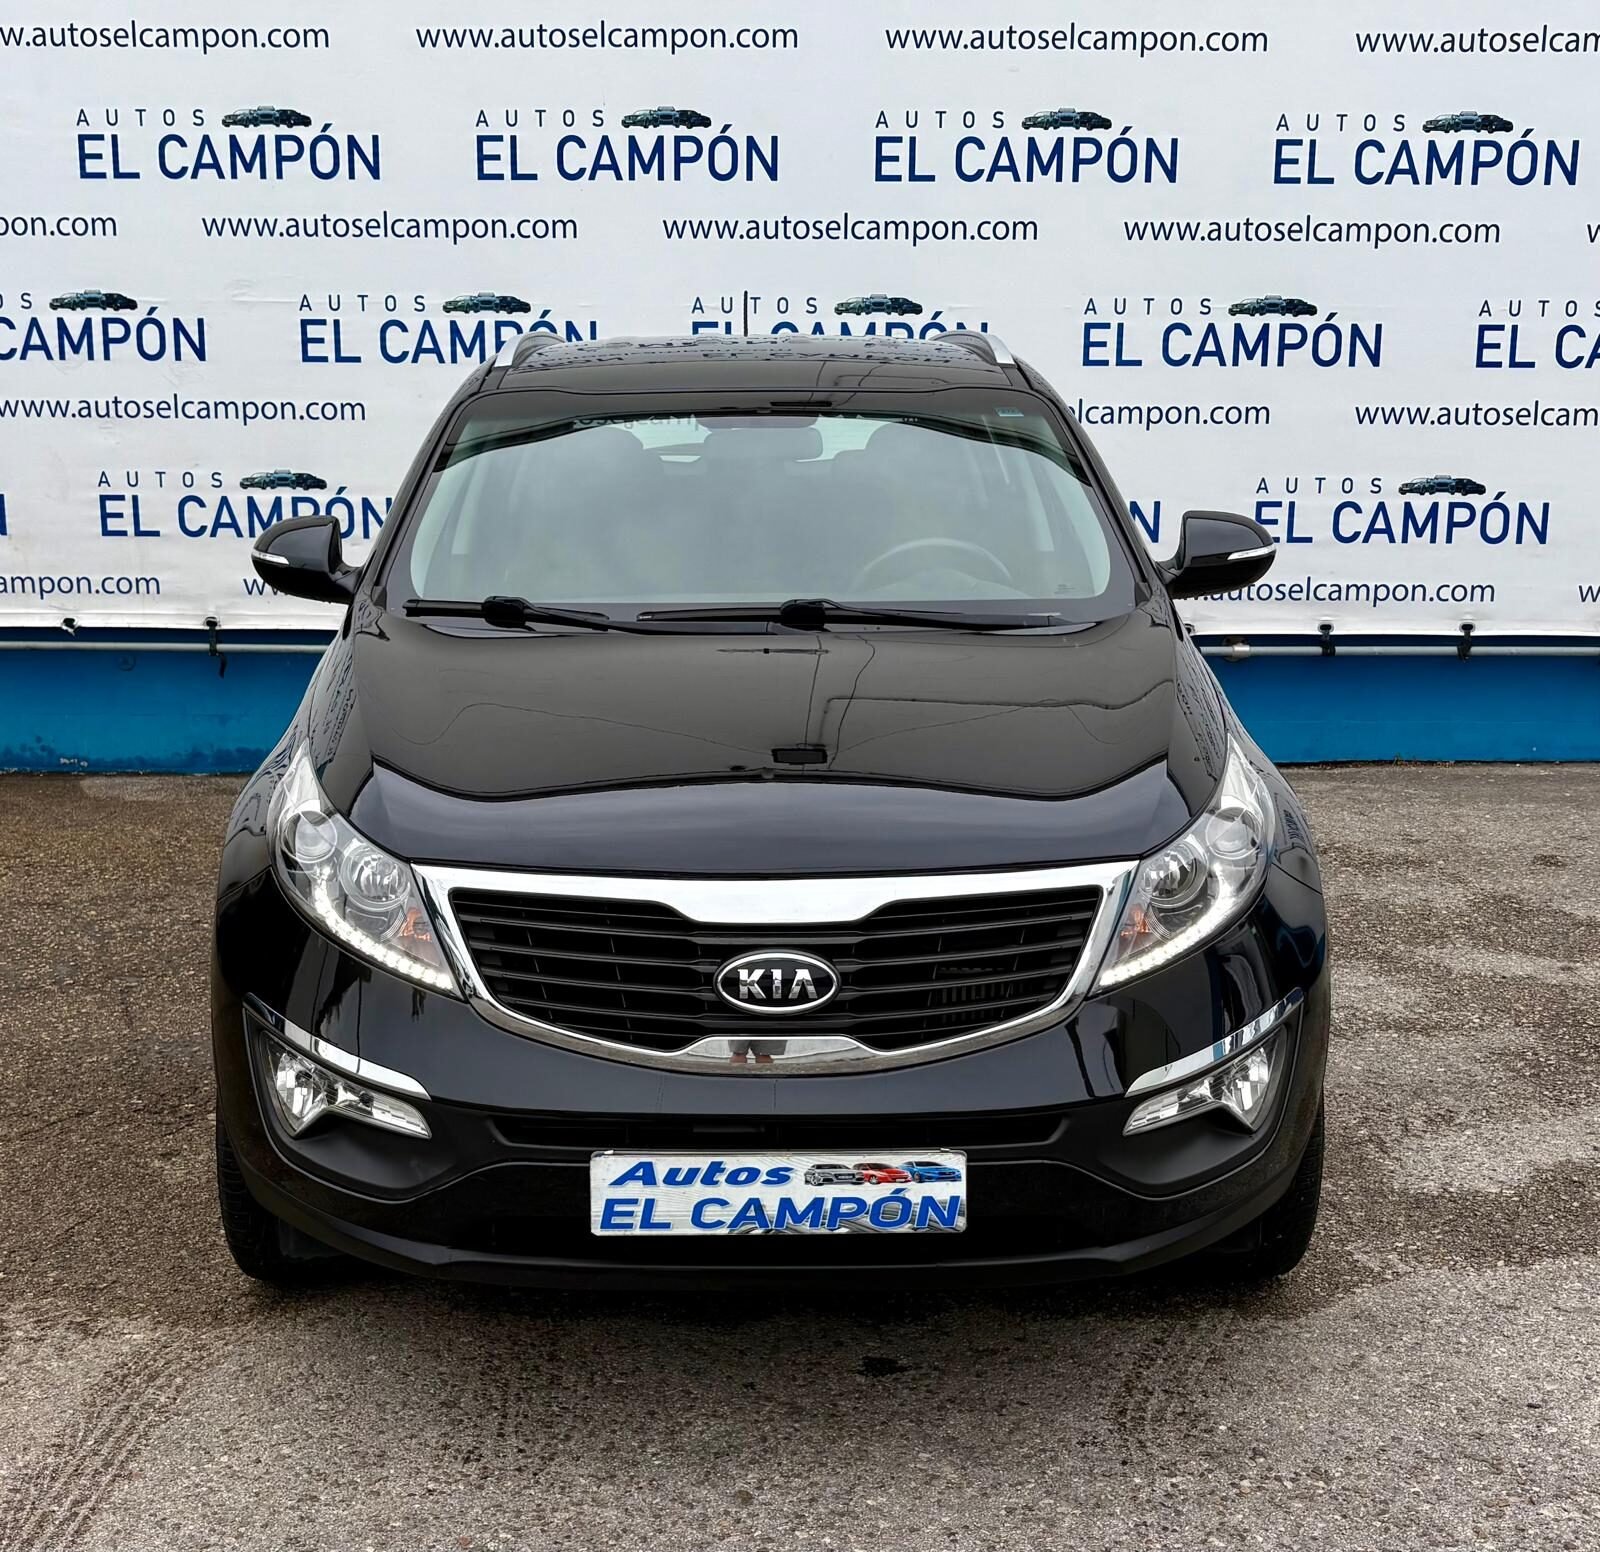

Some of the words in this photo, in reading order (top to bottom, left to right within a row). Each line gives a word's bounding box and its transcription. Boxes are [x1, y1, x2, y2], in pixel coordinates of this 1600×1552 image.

[416, 21, 798, 55] www.autoselcampon.com
[886, 23, 1269, 58] www.autoselcampon.com
[78, 110, 205, 127] AUTOS
[477, 110, 604, 128] AUTOS
[876, 111, 1005, 129] AUTOS
[1277, 114, 1405, 132] AUTOS
[79, 135, 140, 180] EL
[158, 123, 381, 181] CAMPÓN
[477, 136, 538, 181] EL
[557, 124, 779, 182] CAMPÓN
[875, 137, 936, 183] EL
[955, 126, 1179, 184] CAMPÓN
[1274, 139, 1335, 185] EL
[1355, 128, 1580, 187] CAMPÓN
[202, 211, 577, 245] www.autoselcampon.com
[663, 213, 1038, 247] www.autoselcampon.com
[1124, 215, 1500, 249] www.autoselcampon.com
[299, 295, 426, 312] AUTOS
[691, 297, 818, 315] AUTOS
[1085, 298, 1212, 316] AUTOS
[300, 319, 361, 364] EL
[1083, 323, 1145, 368] EL
[1162, 313, 1383, 369] CAMPÓN
[1476, 325, 1536, 369] EL
[0, 394, 366, 426] www.autoselcampon.com
[98, 472, 223, 488] AUTOS
[1256, 477, 1382, 495] AUTOS
[100, 495, 161, 537] EL
[1256, 501, 1313, 544] EL
[1331, 492, 1549, 545] CAMPÓN
[738, 968, 819, 1000] KIA
[609, 1160, 794, 1187] Autos
[600, 1197, 672, 1231] EL
[690, 1187, 962, 1231] CAMPÓN
